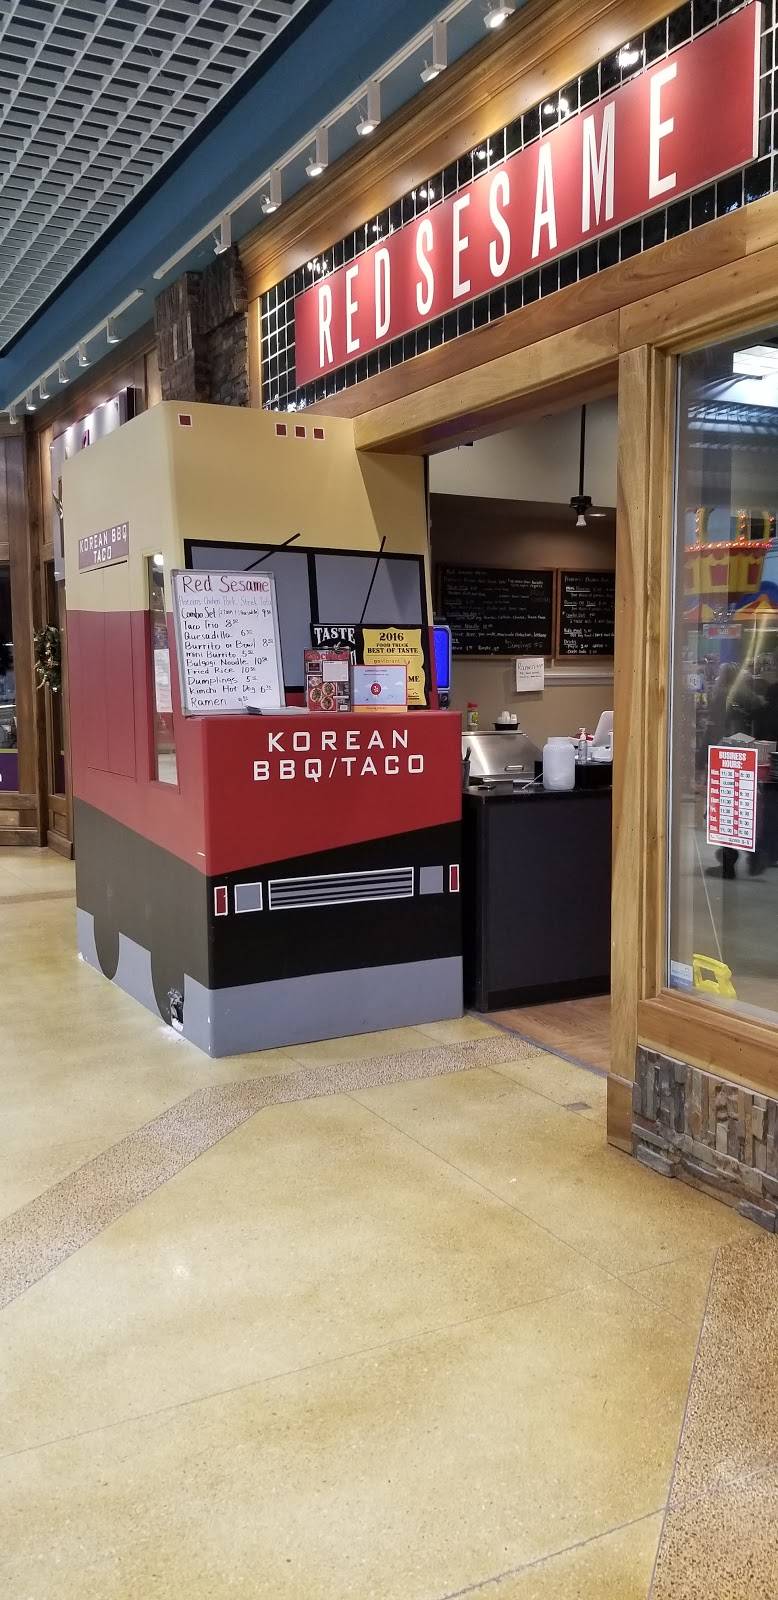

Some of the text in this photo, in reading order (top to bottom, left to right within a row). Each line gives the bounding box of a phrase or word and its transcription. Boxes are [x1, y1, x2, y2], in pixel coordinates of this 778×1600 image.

[319, 63, 678, 368] RED SESAME
[79, 524, 128, 552] KOREAN BBQ
[93, 545, 112, 564] TACO
[182, 575, 270, 593] Red Sesame
[182, 608, 204, 619] Combo
[204, 607, 217, 619] Set
[184, 621, 201, 630] Taco
[204, 620, 219, 630] Trio
[314, 627, 356, 645] TASTE
[379, 632, 404, 642] 2016
[184, 641, 221, 650] Burrito
[235, 639, 256, 649] Bowl
[207, 650, 237, 658] Burrito
[186, 659, 217, 667] Bulgogi
[220, 658, 249, 666] Noodle
[188, 676, 238, 686] Dumplings
[189, 687, 217, 695] Kimchi
[242, 685, 256, 694] Dog
[191, 697, 227, 708] Ramen
[268, 729, 408, 752] KOREAN
[719, 751, 747, 761] BUSINESS
[253, 754, 424, 783] BBQ/TACO
[722, 760, 743, 769] HOURS:
